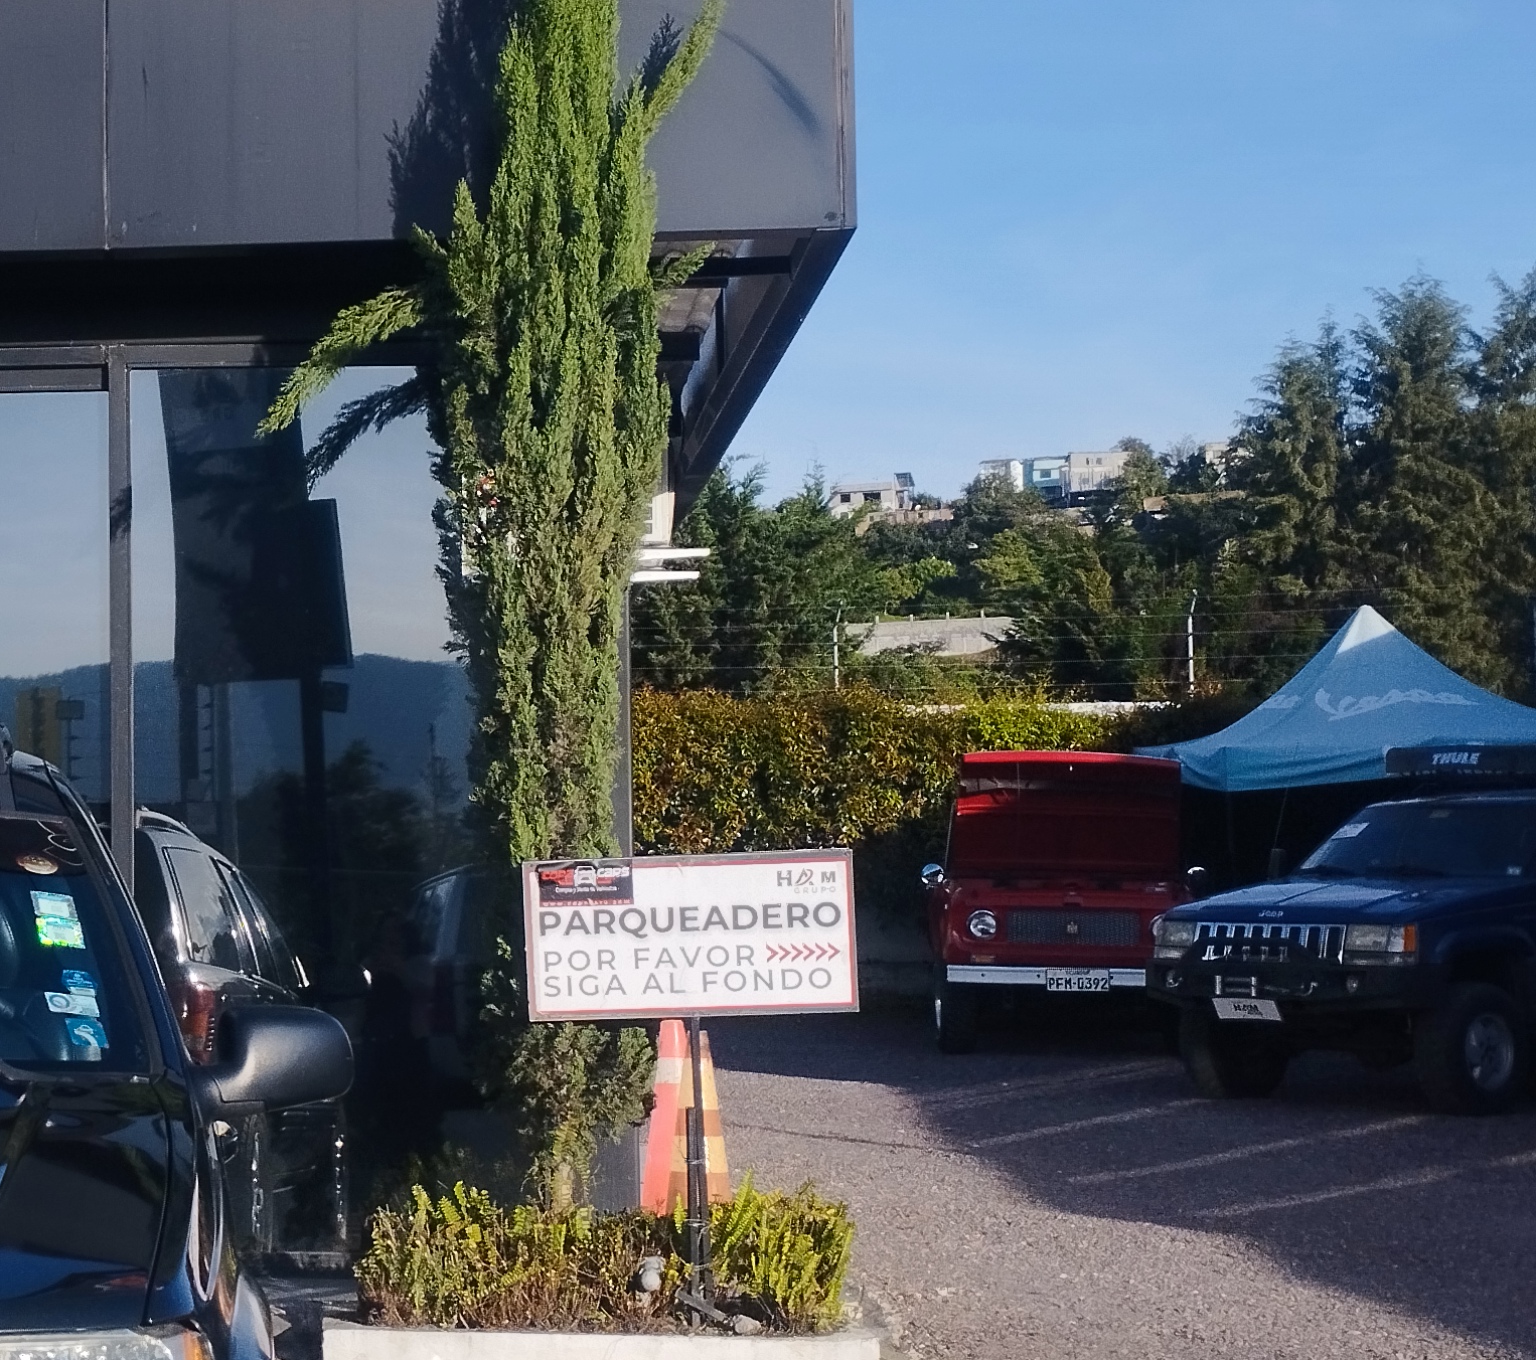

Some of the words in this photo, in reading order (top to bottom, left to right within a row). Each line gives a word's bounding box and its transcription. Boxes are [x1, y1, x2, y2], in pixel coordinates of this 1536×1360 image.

[1431, 752, 1481, 765] THULE
[793, 885, 837, 894] GRUPO
[539, 901, 842, 938] PARQUEADERO
[544, 949, 616, 972] POR
[633, 944, 756, 970] FAVOR
[543, 973, 627, 997] SIGA
[642, 972, 686, 996] AL
[701, 967, 833, 992] FONDO
